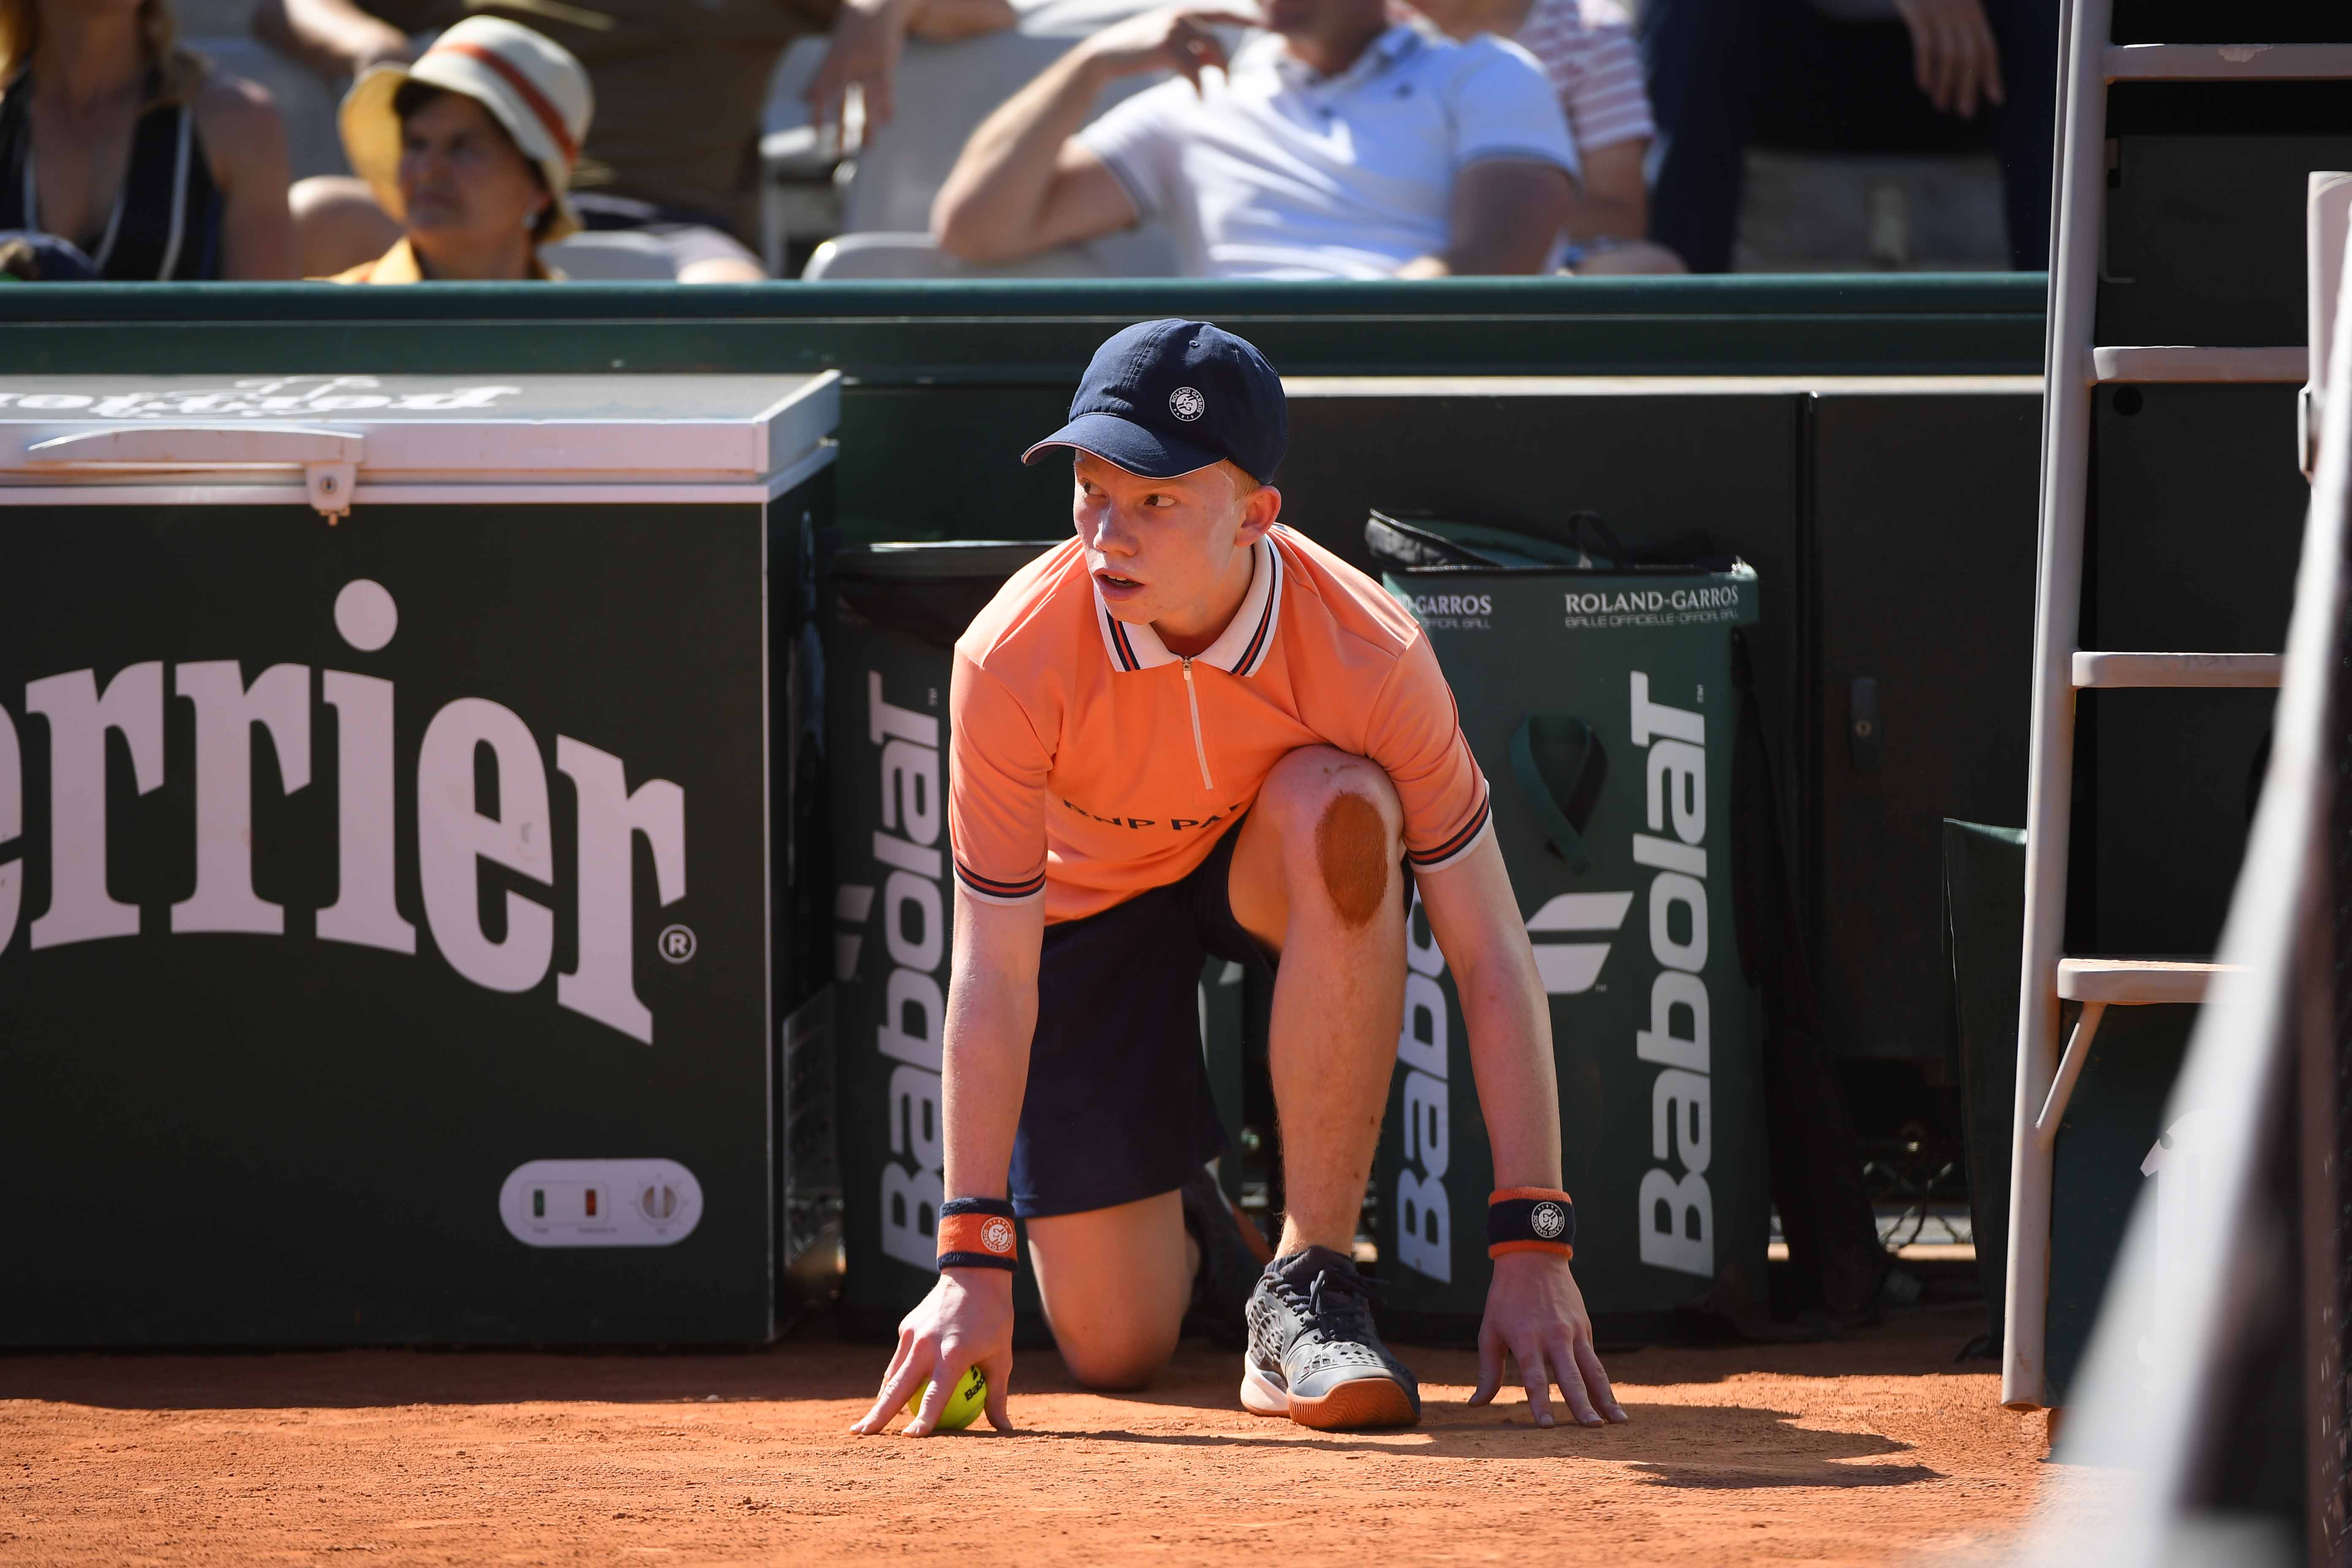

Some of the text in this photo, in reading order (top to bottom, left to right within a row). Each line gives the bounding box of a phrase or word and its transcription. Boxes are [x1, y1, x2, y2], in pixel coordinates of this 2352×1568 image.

[1171, 389, 1203, 414] ROLAND GARROS
[1565, 585, 1739, 614] ROLAND-GARROS
[0, 579, 686, 1046] rrier
[1171, 801, 1243, 830] PA
[1396, 879, 1451, 1285] Babo
[1533, 1215, 1563, 1236] ROLAND GARROS
[964, 1371, 985, 1402] Babo
